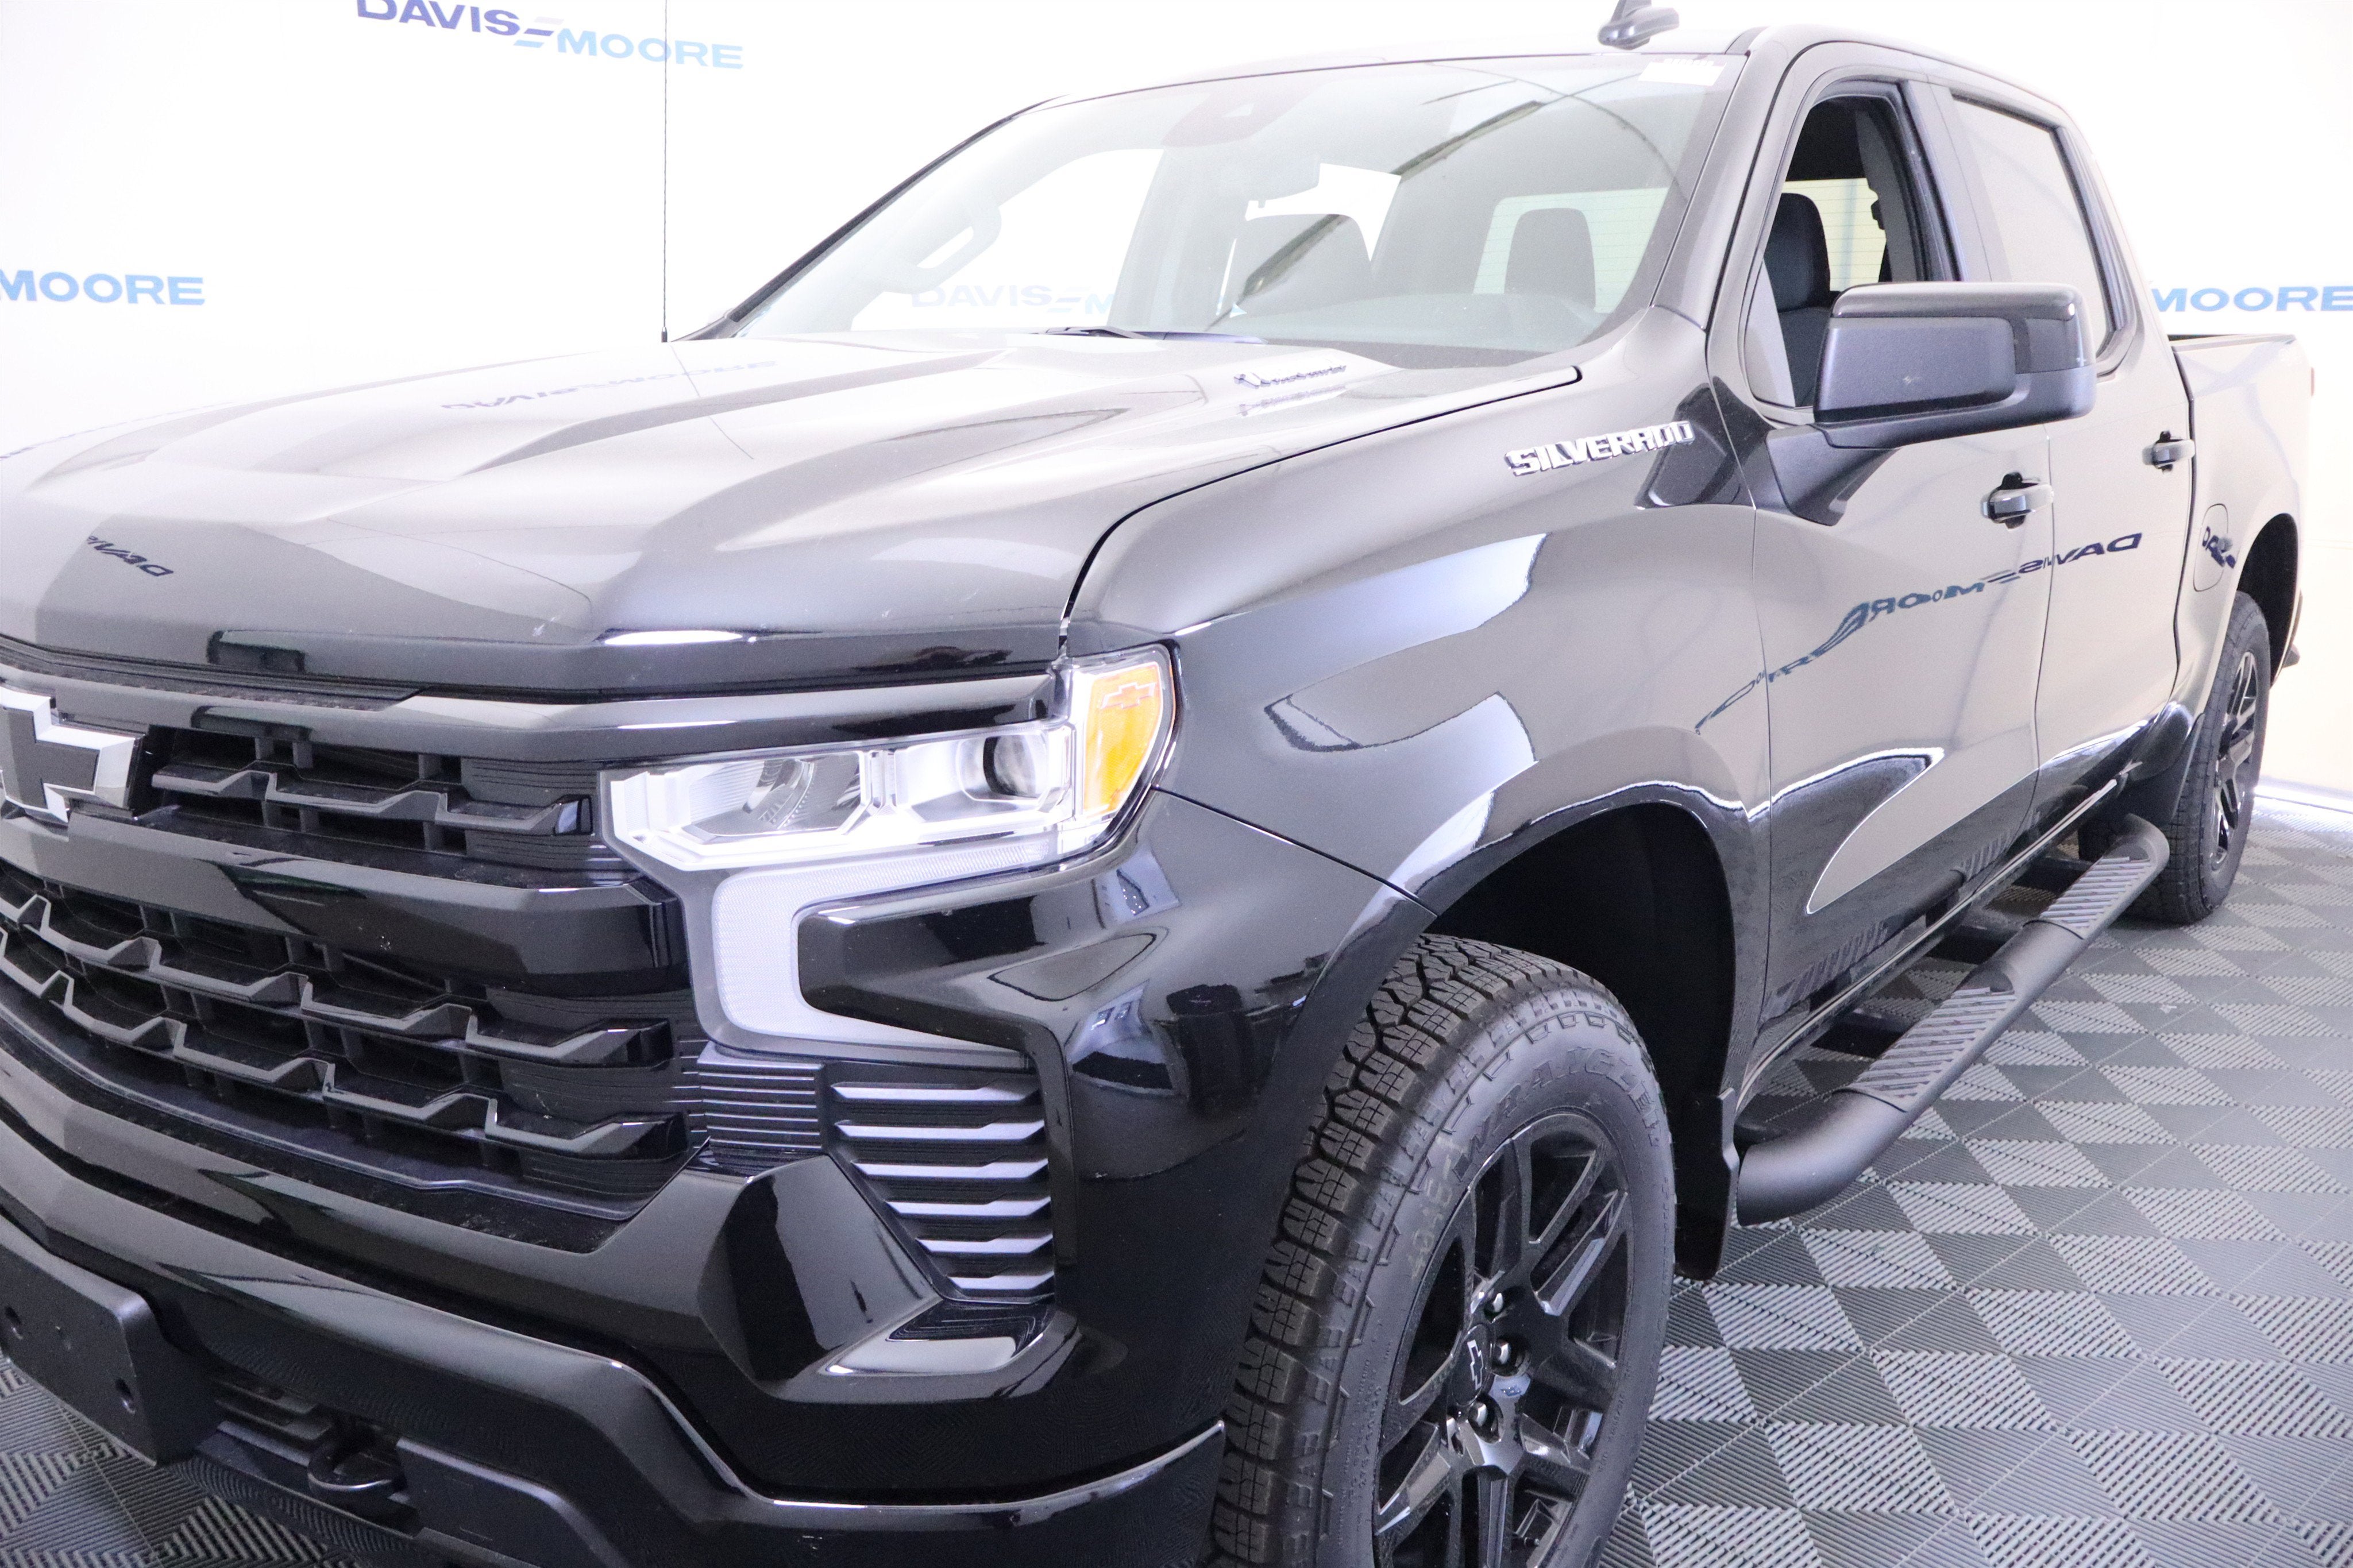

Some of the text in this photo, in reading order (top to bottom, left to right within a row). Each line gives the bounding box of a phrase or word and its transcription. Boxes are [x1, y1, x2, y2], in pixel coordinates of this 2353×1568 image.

[357, 0, 743, 69] DAVIS MOORE
[0, 269, 206, 306] MOORE
[1503, 420, 1696, 477] SILVERADO
